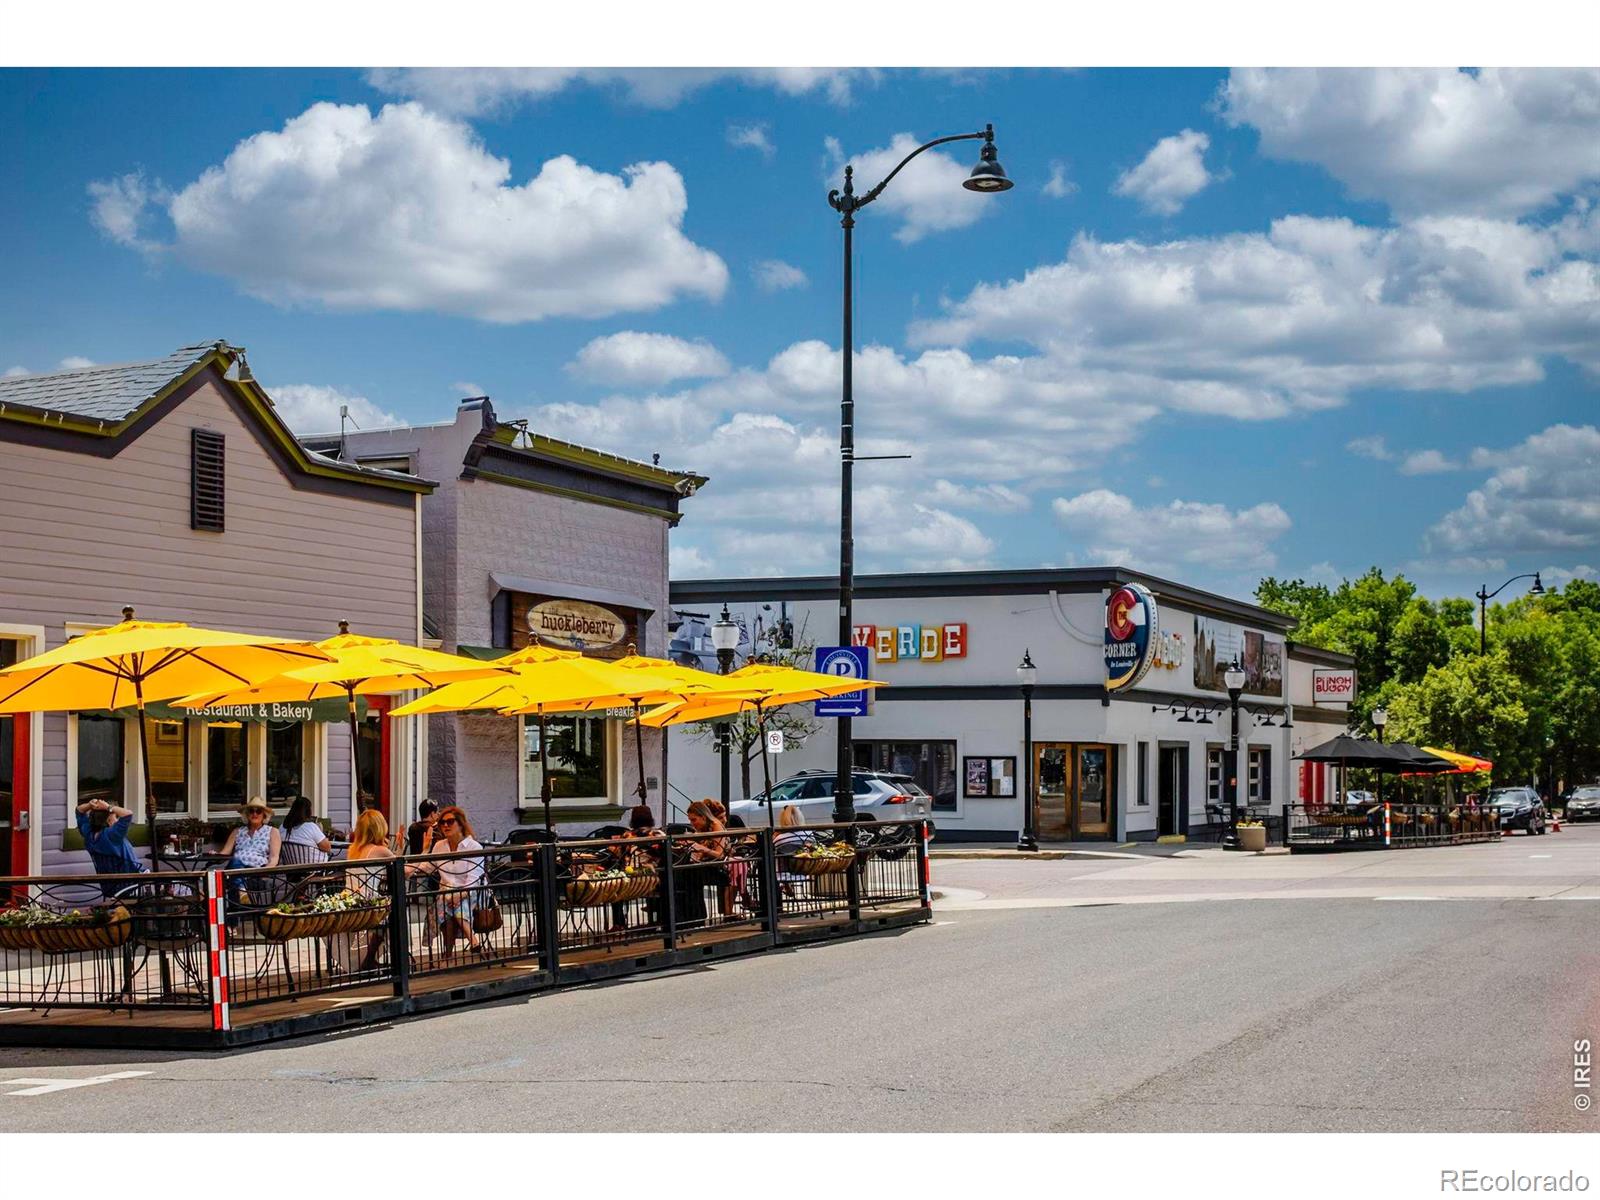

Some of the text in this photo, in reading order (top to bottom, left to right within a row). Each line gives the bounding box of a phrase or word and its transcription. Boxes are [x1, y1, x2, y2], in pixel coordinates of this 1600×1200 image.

[541, 612, 615, 639] huckleberry
[853, 625, 961, 659] VERDE
[1104, 642, 1137, 658] CORNER
[259, 703, 268, 717] &
[273, 703, 313, 720] Bakery
